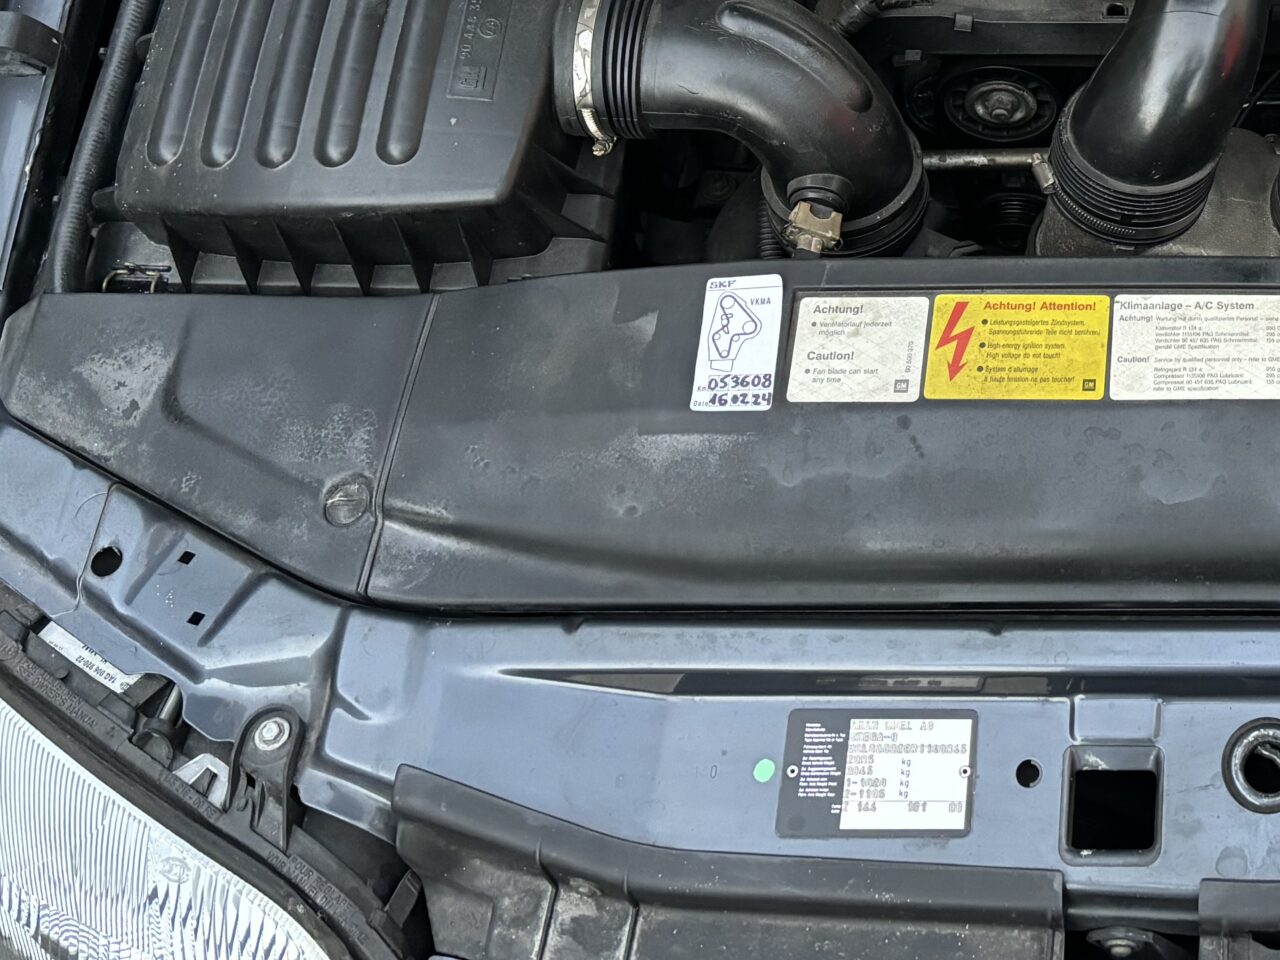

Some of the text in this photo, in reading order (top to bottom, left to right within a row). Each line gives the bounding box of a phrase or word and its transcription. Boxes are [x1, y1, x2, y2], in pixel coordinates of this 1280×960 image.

[709, 279, 737, 289] SKF
[750, 298, 772, 306] VKMA
[983, 301, 1097, 313] Achtung! Attention!
[1119, 301, 1183, 311] Klimaanlage
[1194, 301, 1213, 311] A/C
[1216, 301, 1255, 312] System
[813, 305, 864, 316] Achtung!
[1119, 315, 1153, 323] Achtung!
[807, 351, 855, 361] Caution!
[1117, 355, 1150, 363] Caution!
[707, 373, 772, 391] 053608
[751, 392, 772, 406] 24
[901, 758, 912, 767] kg
[900, 768, 911, 778] kg
[899, 778, 910, 788] kg
[898, 789, 909, 798] kg
